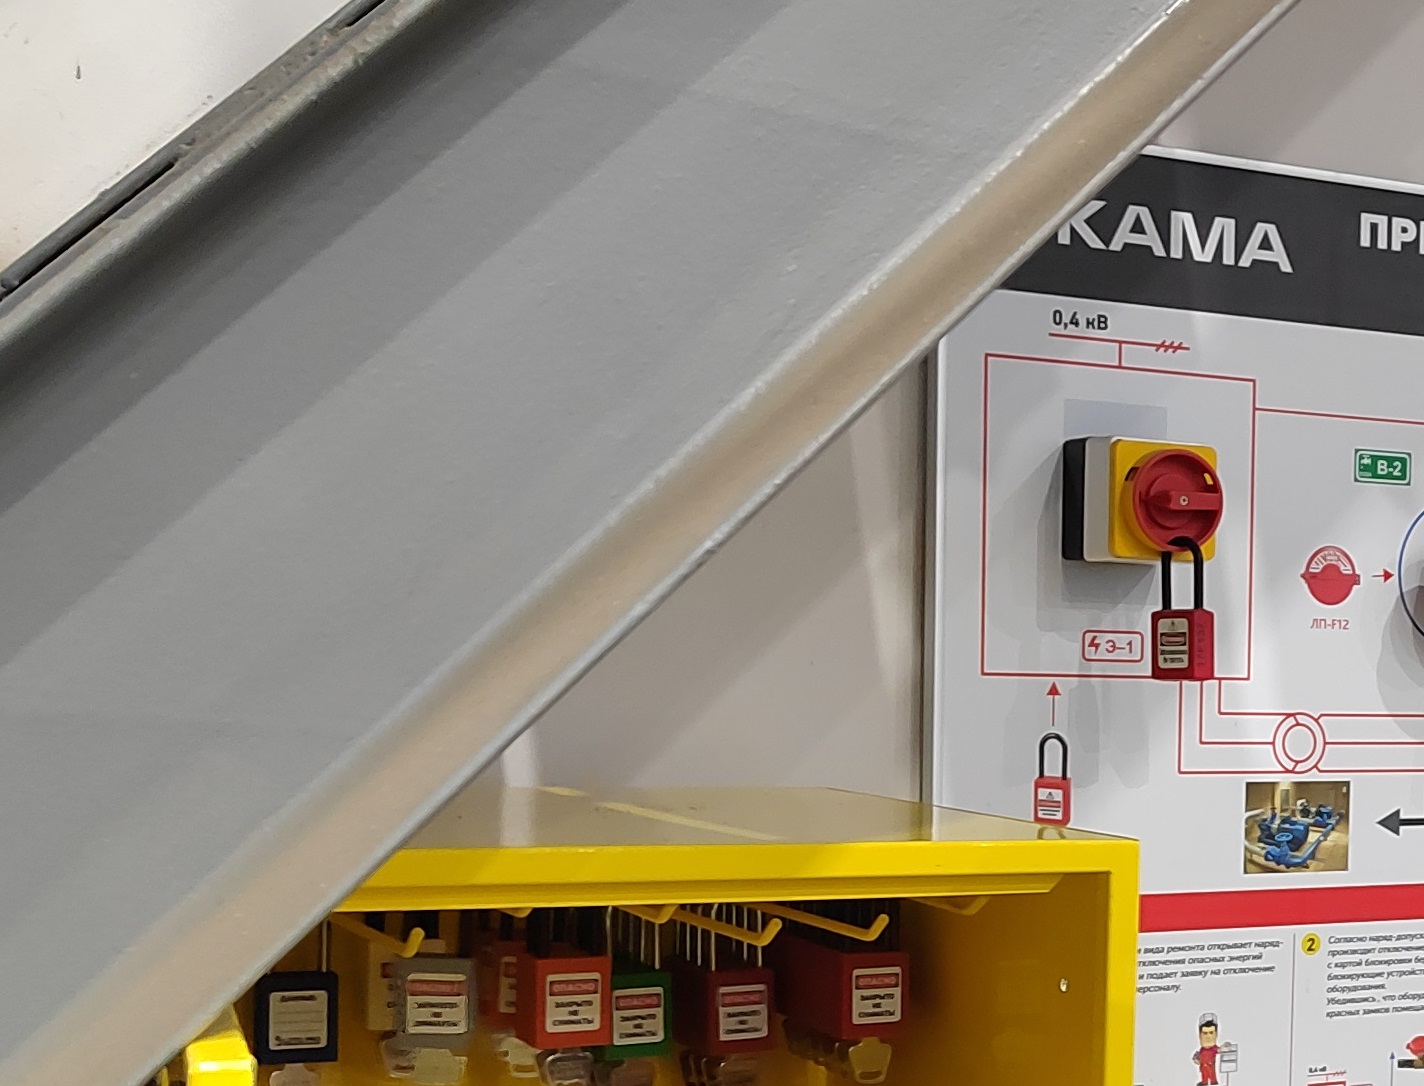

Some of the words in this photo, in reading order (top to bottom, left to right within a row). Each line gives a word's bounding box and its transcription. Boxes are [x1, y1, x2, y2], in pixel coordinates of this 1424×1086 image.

[1053, 309, 1080, 330] 0,4
[1086, 314, 1109, 331] кВ
[1377, 459, 1402, 476] В-2
[1310, 618, 1350, 630] ЛП-F12
[1105, 639, 1133, 654] Э-1
[1306, 937, 1316, 952] 2
[1138, 959, 1185, 967] тключения
